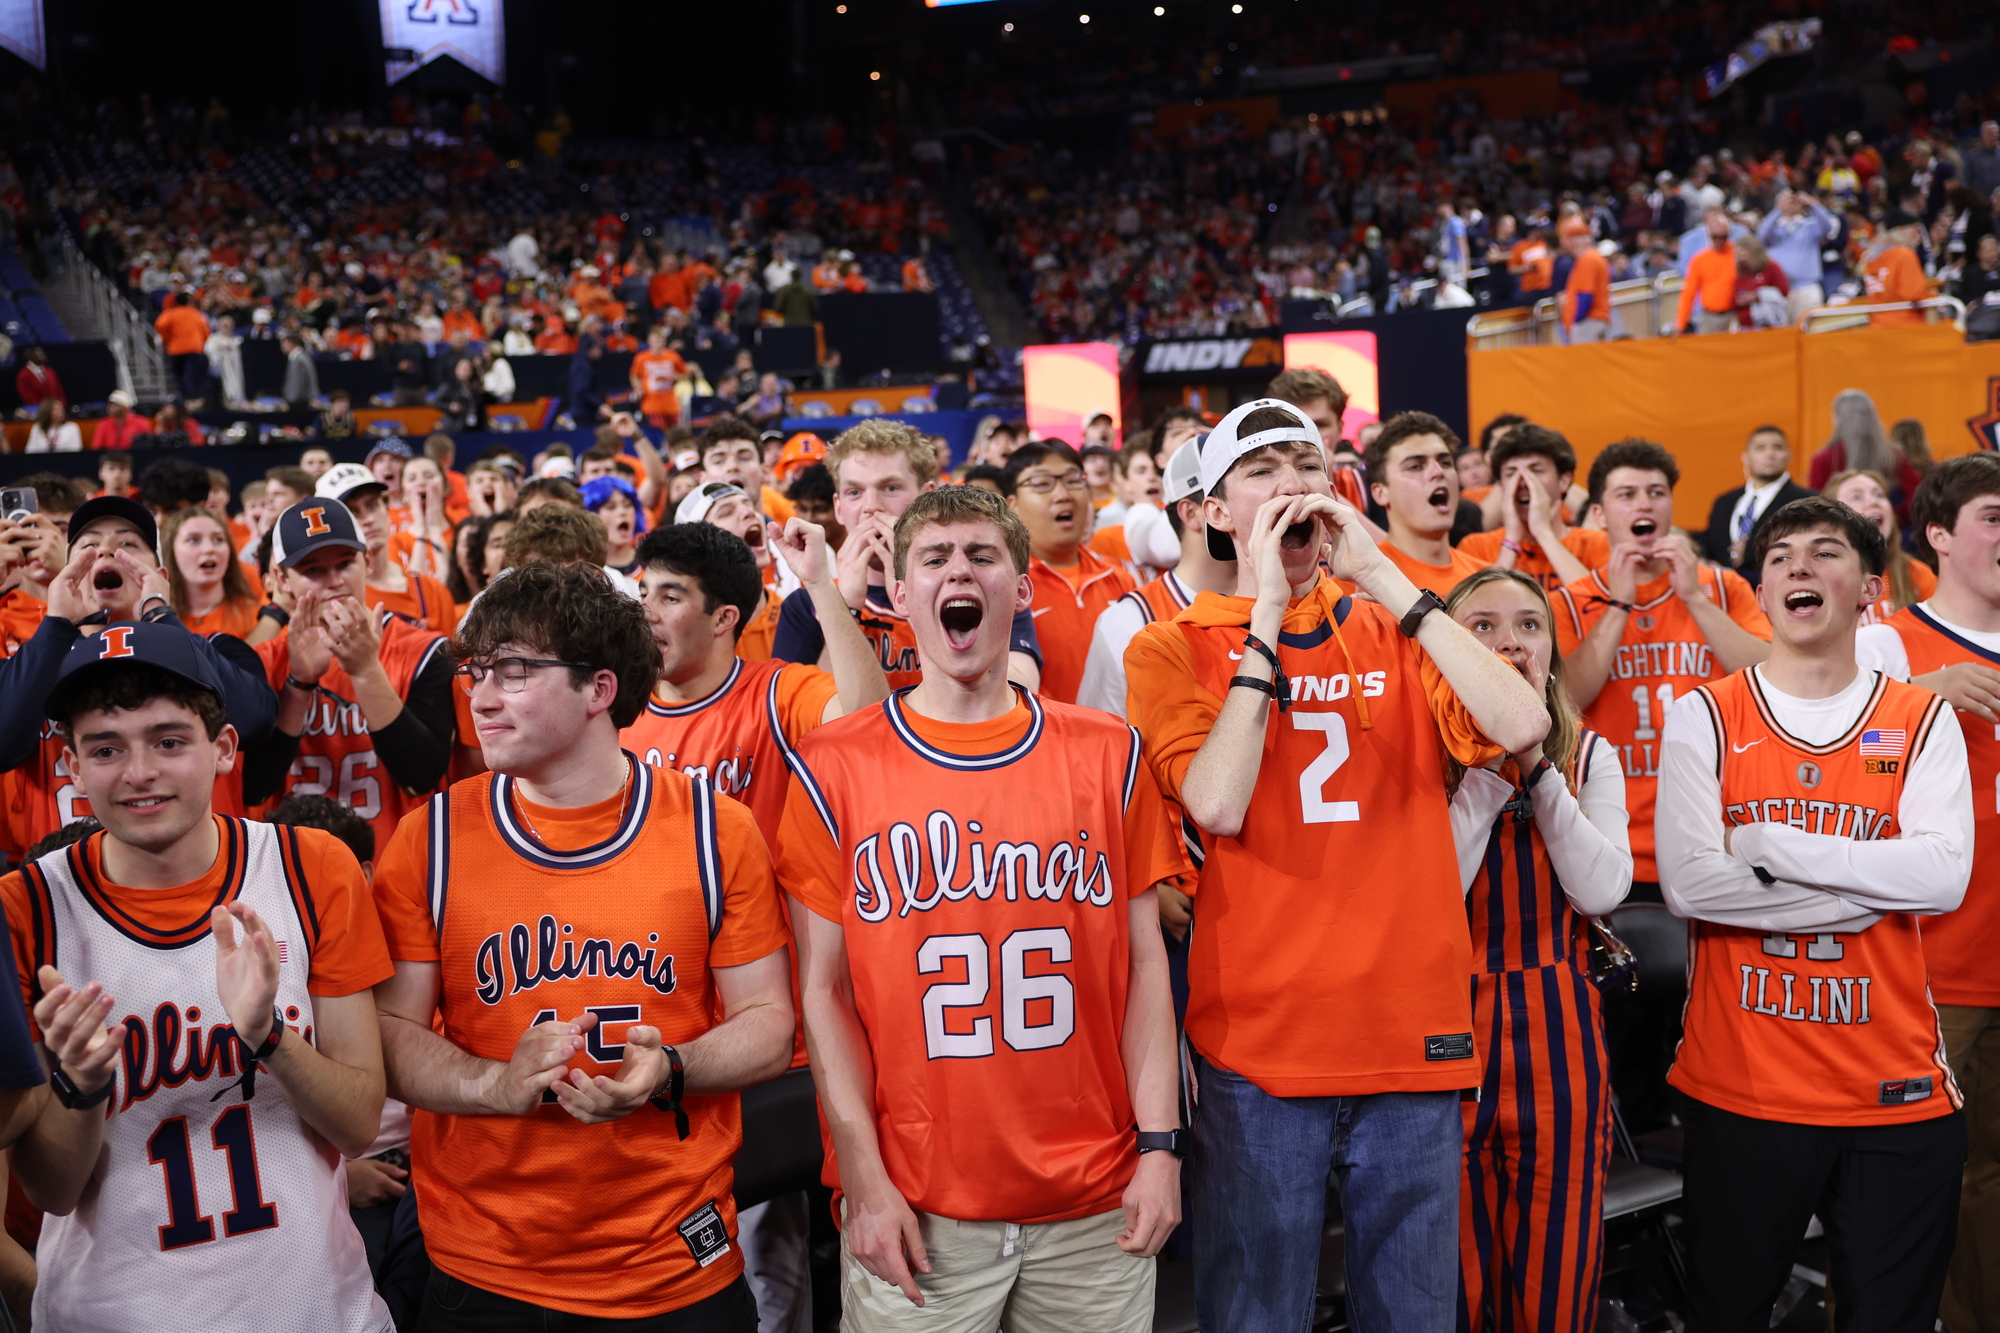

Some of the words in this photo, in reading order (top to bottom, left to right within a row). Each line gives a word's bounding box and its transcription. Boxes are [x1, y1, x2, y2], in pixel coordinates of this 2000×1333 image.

[1144, 338, 1253, 373] INDY
[301, 506, 332, 537] I
[100, 626, 134, 659] I
[1291, 711, 1360, 824] 2
[854, 809, 1113, 923] Illinois
[475, 914, 677, 1006] Illinois
[916, 926, 1075, 1061] 26
[1739, 964, 1871, 1025] ILLINI
[147, 1103, 279, 1251] 11
